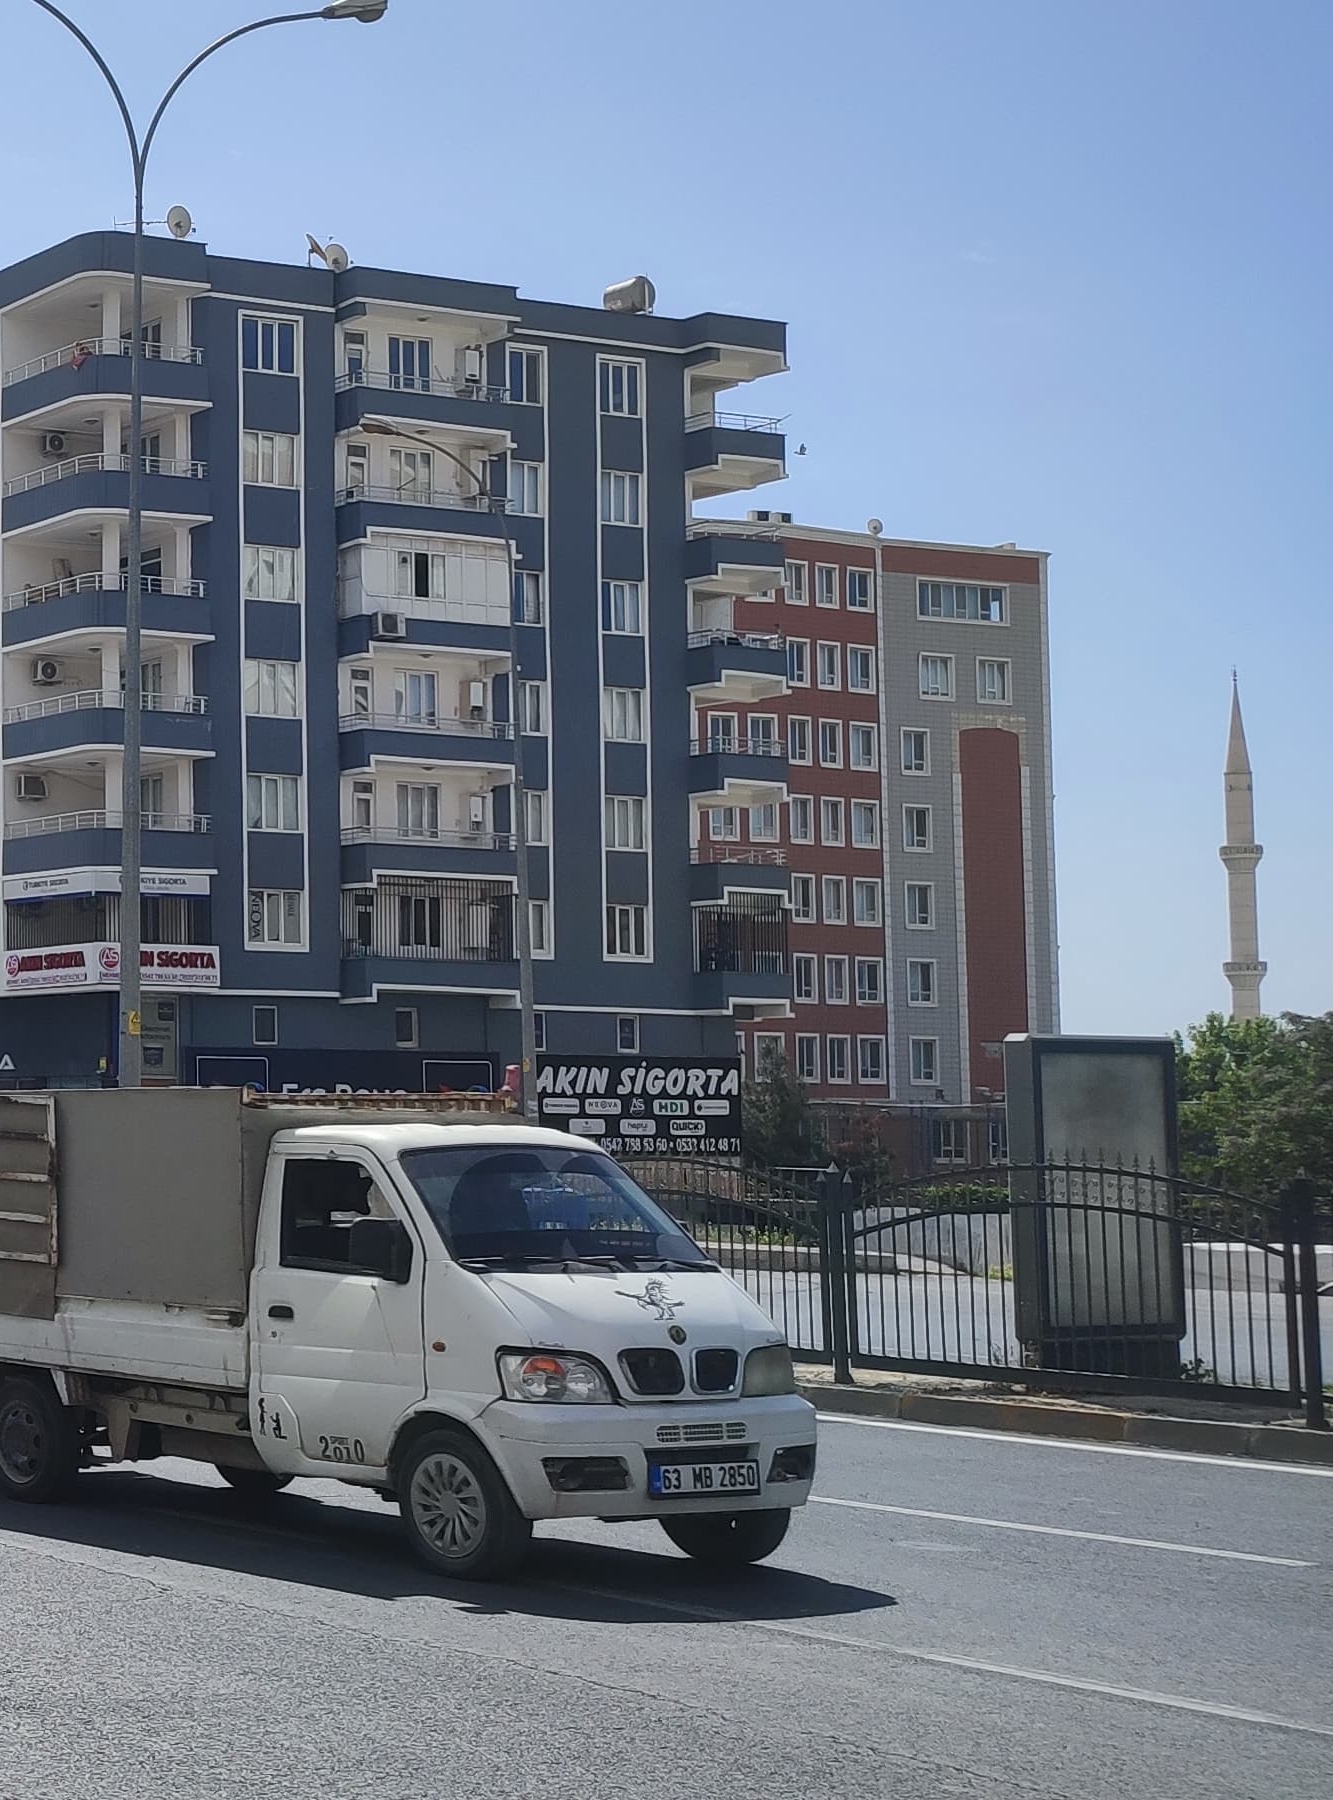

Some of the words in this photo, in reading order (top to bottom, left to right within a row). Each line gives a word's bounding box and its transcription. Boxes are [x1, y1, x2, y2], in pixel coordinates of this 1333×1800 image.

[536, 1066, 610, 1096] AKIN
[617, 1060, 739, 1098] SİGORTA
[658, 1101, 685, 1114] HDI
[699, 1138, 716, 1152] 412
[662, 1468, 682, 1490] 63
[692, 1466, 713, 1489] MB
[717, 1464, 755, 1487] 2850
